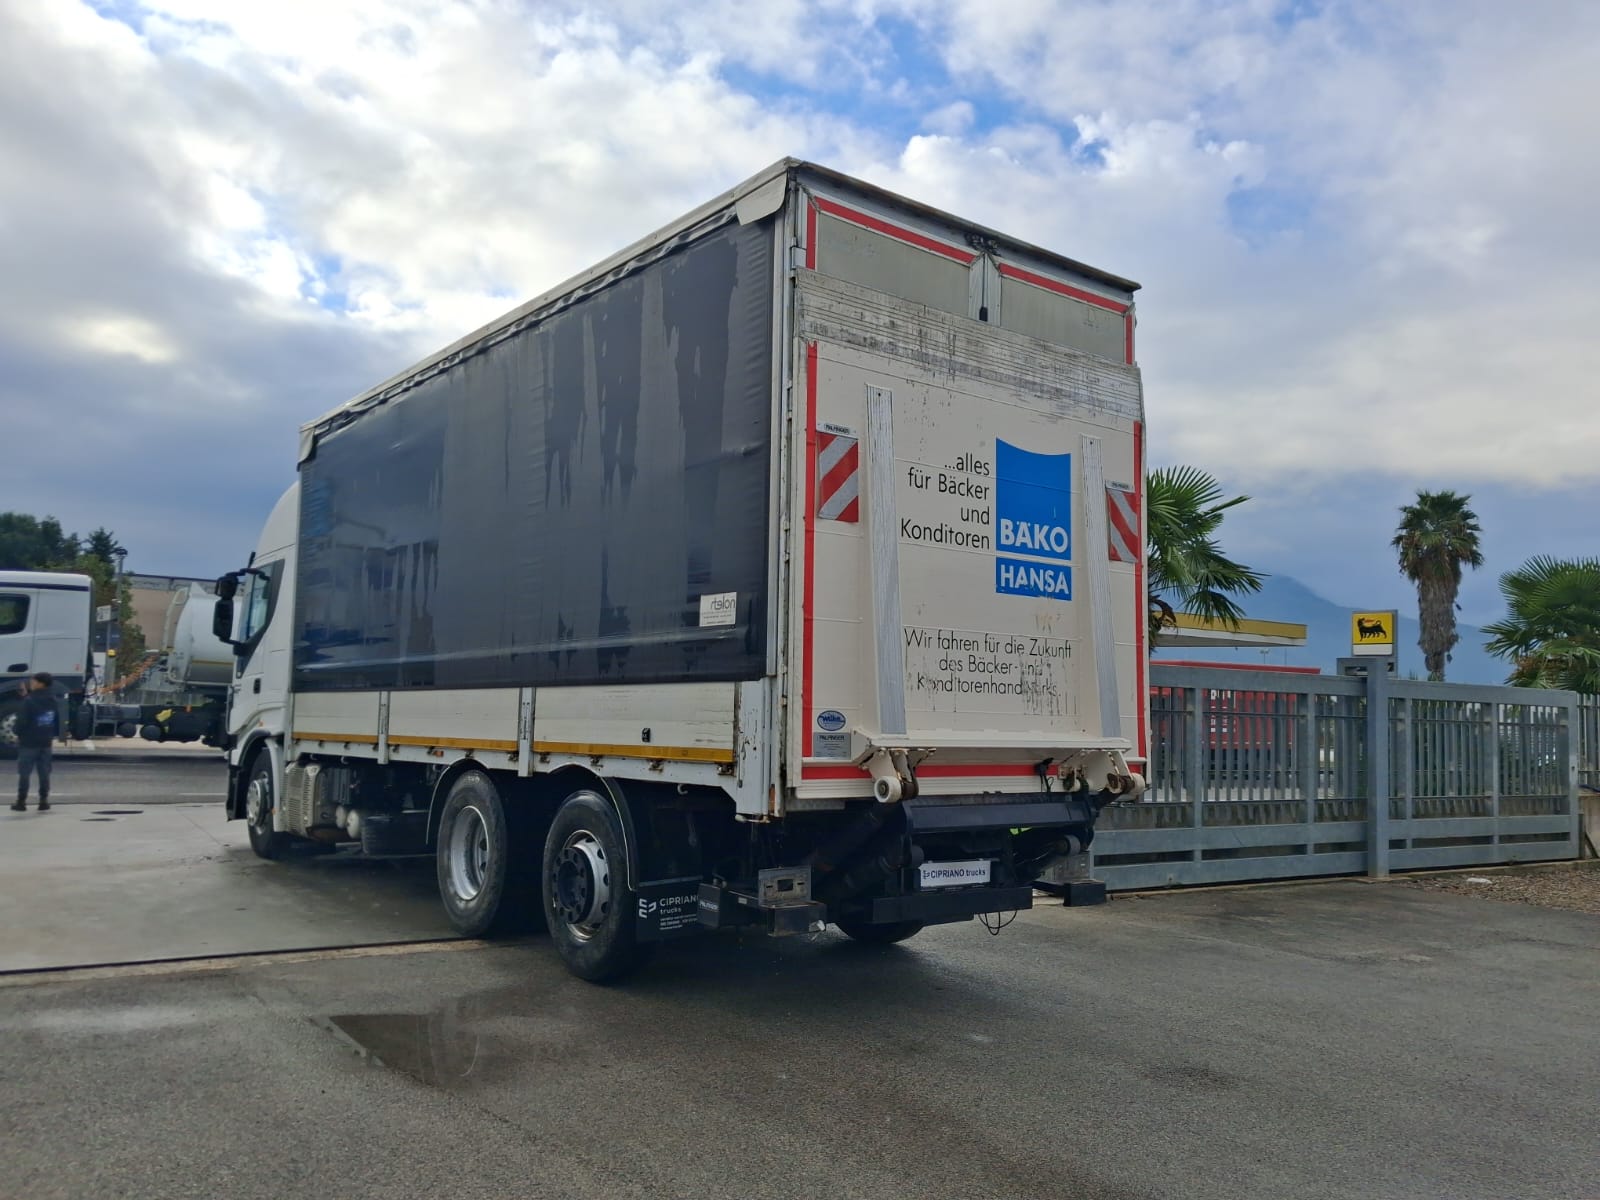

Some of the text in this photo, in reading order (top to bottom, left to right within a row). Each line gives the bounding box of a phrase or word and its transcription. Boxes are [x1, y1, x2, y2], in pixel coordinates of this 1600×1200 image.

[907, 466, 990, 501] für Bäcker
[960, 505, 990, 526] und
[900, 517, 990, 550] Konditoren
[1000, 518, 1069, 553] BÄKO
[1000, 564, 1070, 594] HANSA
[903, 627, 1072, 660] Wir fahren für die Zukunft
[939, 650, 964, 672] des
[930, 868, 987, 879] CIPRIANO trucks
[659, 895, 699, 907] CIPRIAN
[660, 907, 682, 915] trucks
